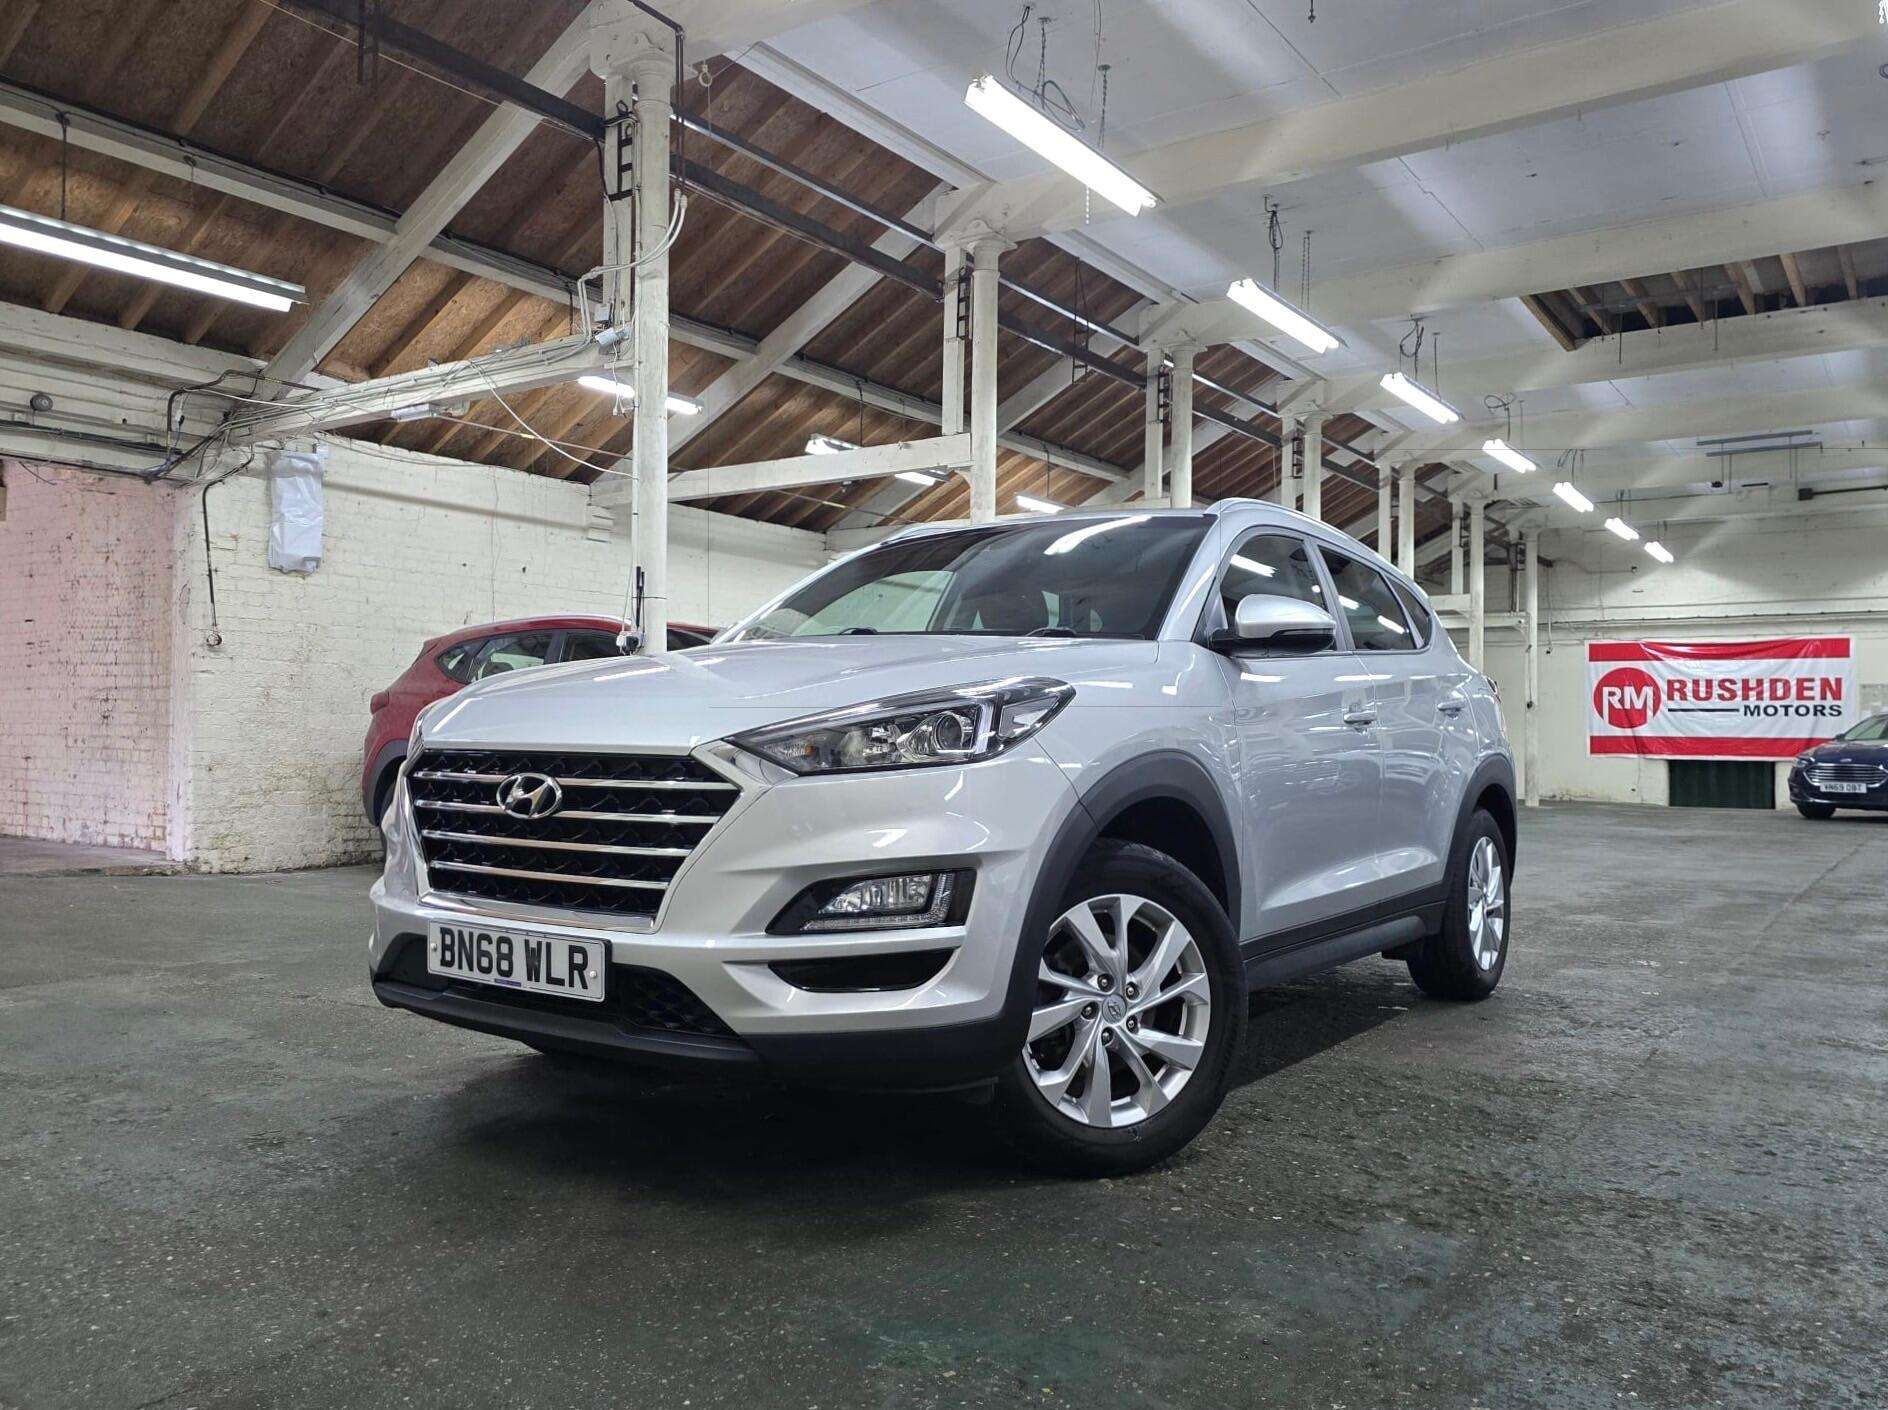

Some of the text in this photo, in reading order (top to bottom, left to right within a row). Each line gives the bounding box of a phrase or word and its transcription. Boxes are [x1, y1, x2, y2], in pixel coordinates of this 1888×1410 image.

[1602, 685, 1654, 720] RM
[1666, 677, 1843, 702] RUSHDEN
[1743, 704, 1843, 717] MOTORS
[439, 926, 589, 990] BN68 WLR
